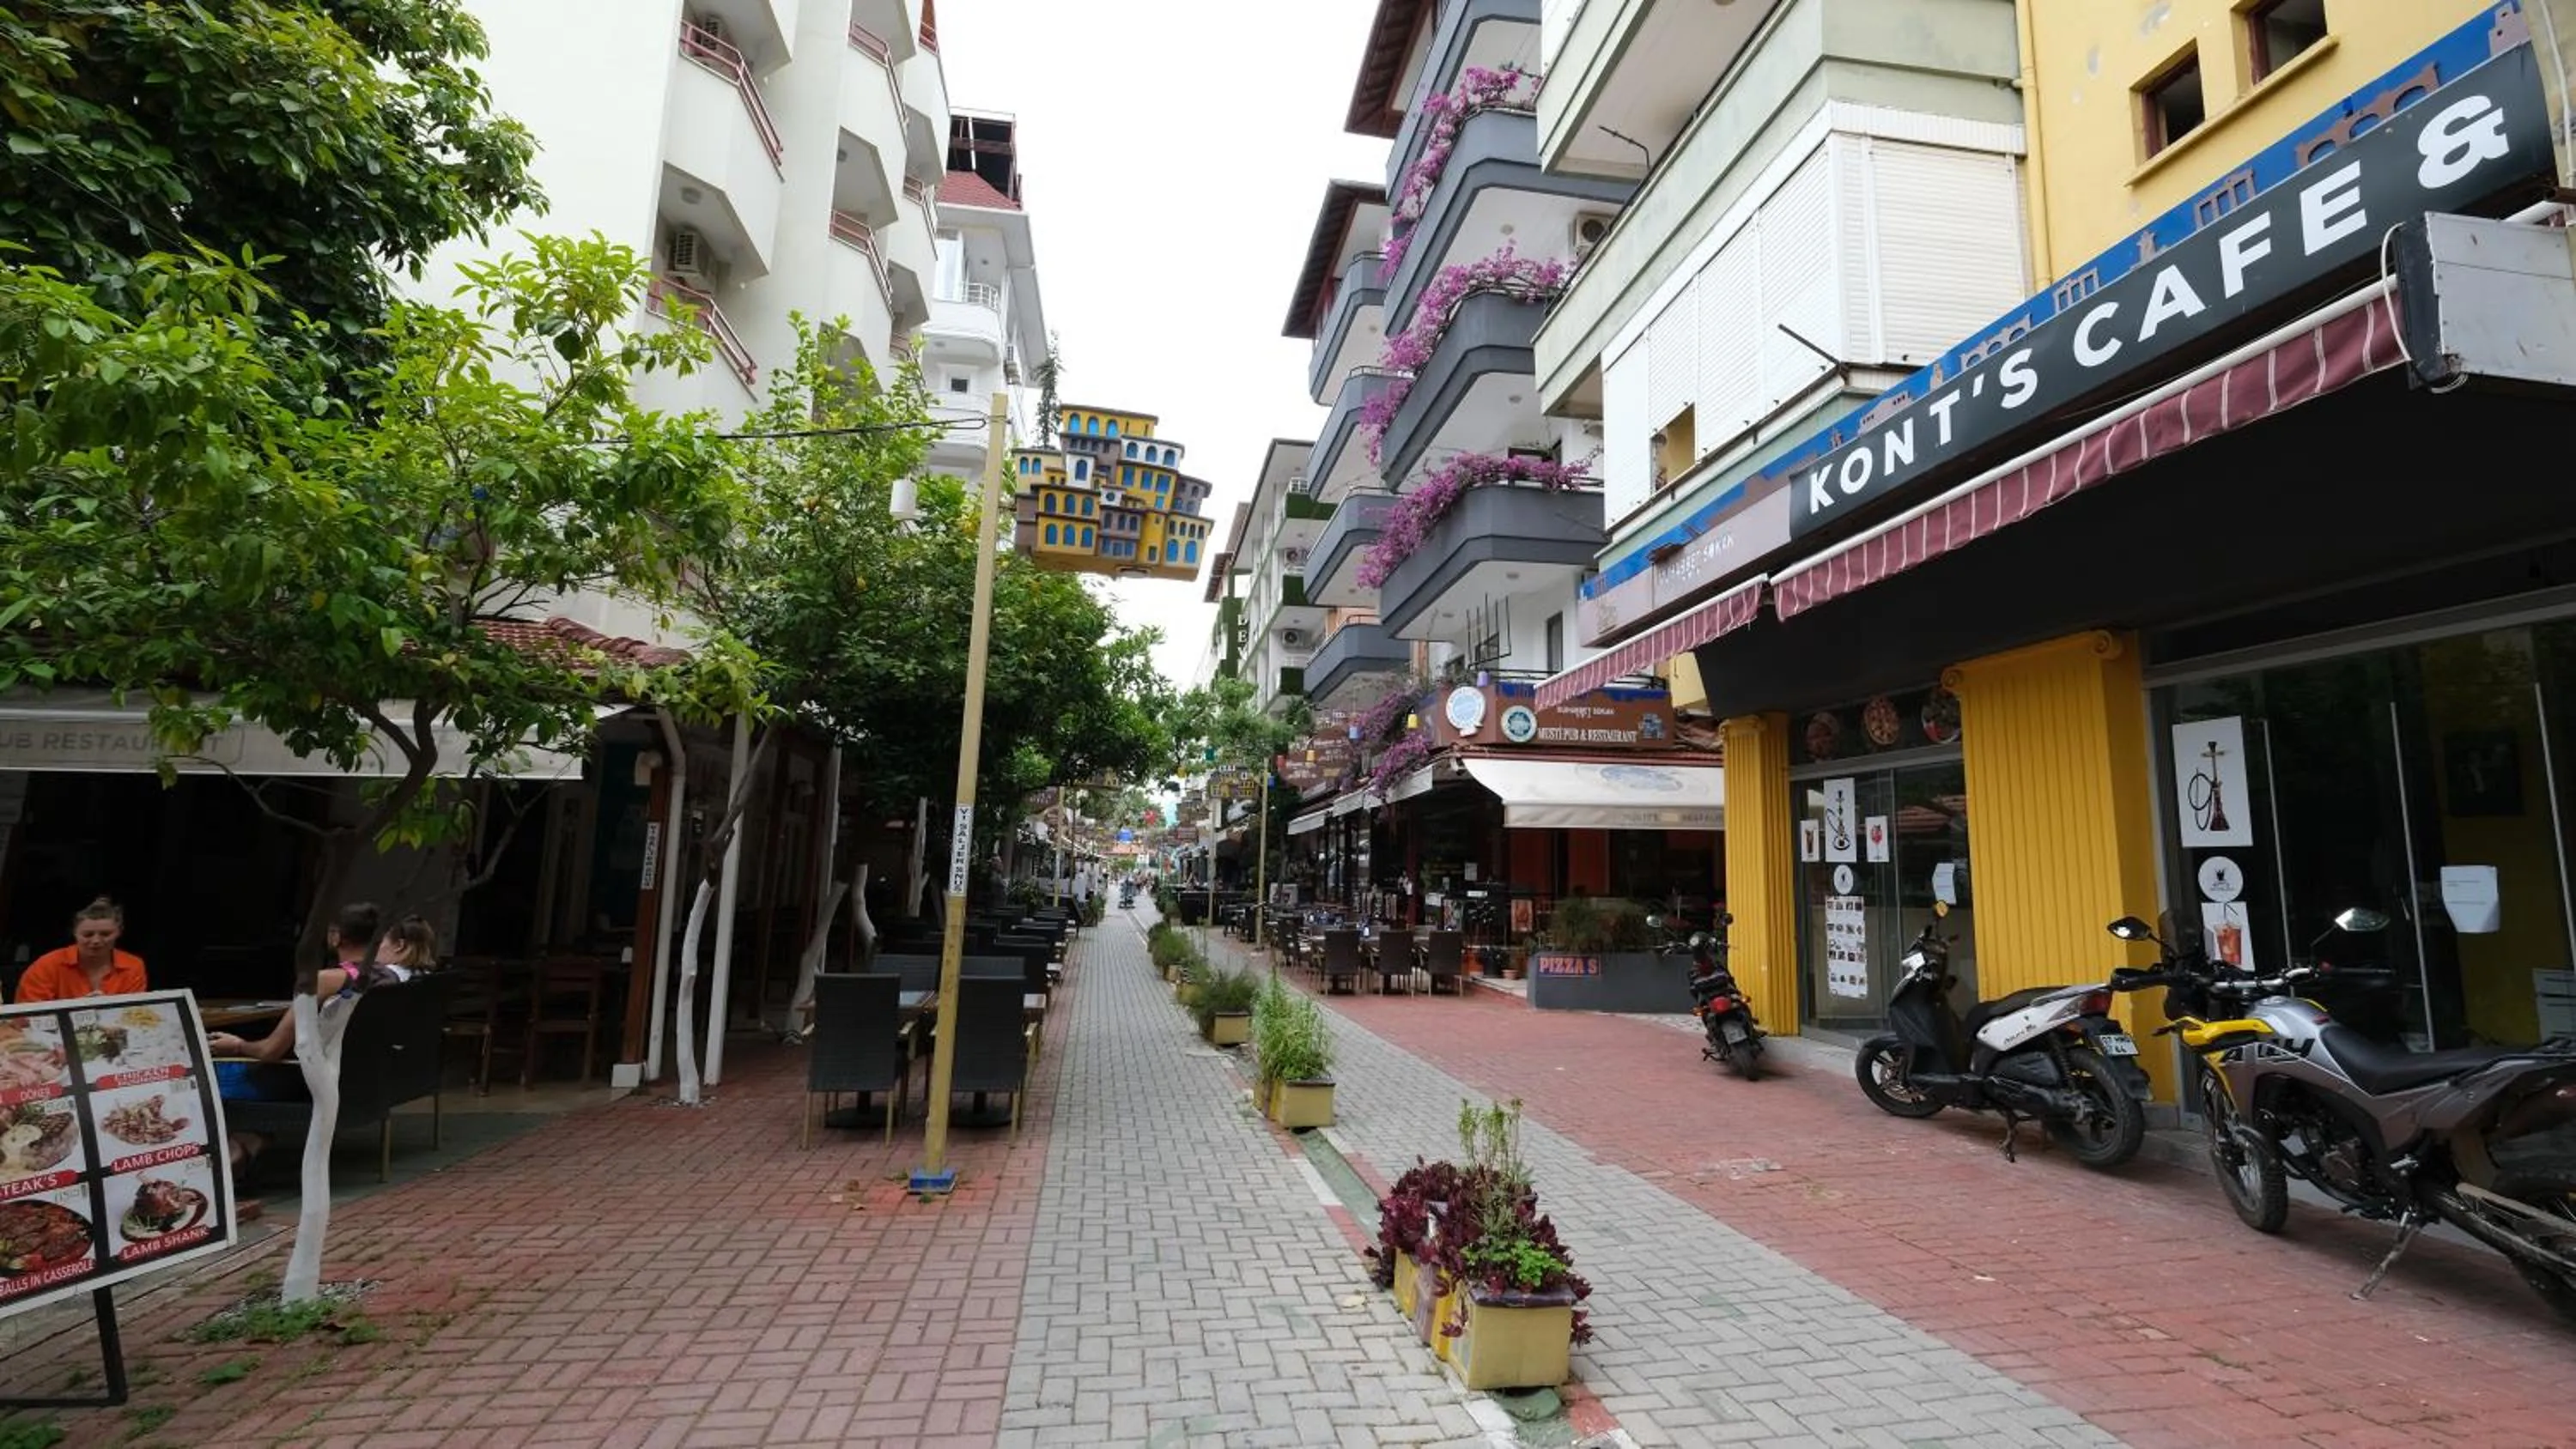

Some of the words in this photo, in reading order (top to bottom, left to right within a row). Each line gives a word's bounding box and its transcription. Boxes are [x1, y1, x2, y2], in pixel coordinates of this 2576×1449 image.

[1810, 348, 2038, 514] KONT'S
[2073, 161, 2367, 367] CAFE
[2417, 94, 2510, 189] &
[1539, 957, 1584, 973] PIZZA
[113, 1155, 153, 1172] LAMB
[158, 1143, 199, 1163] CHOPS
[0, 1173, 58, 1197] TEAK'S
[122, 1241, 161, 1259] LAMB
[163, 1226, 210, 1248] SHANK
[30, 1273, 40, 1286] IN
[43, 1259, 96, 1284] CASSEROLE
